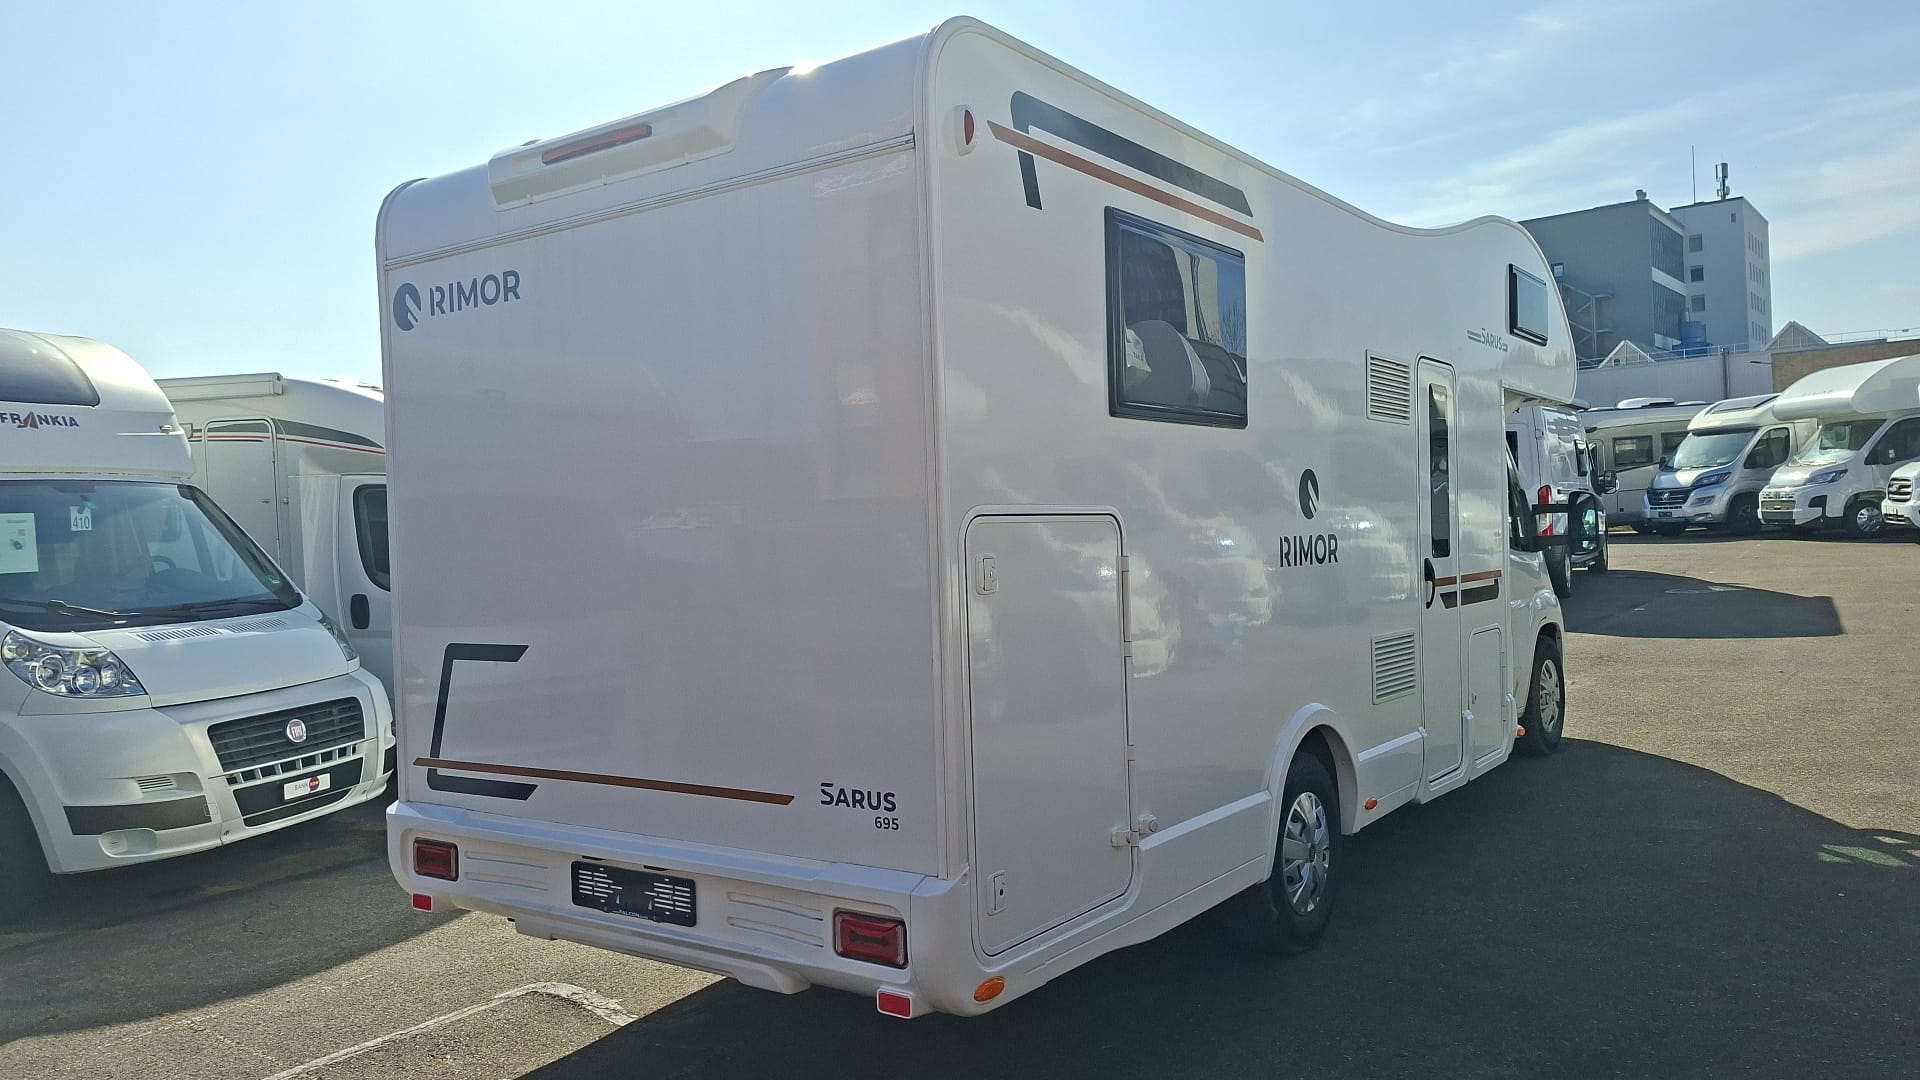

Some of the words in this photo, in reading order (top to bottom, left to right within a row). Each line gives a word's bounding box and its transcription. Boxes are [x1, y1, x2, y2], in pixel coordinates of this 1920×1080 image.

[430, 270, 520, 316] RIMOR
[1481, 328, 1503, 351] SARUS
[0, 411, 79, 429] FRANKIA
[72, 516, 90, 529] 410
[1280, 534, 1338, 567] RIMOR
[820, 782, 896, 812] SARUS
[874, 816, 899, 830] 695
